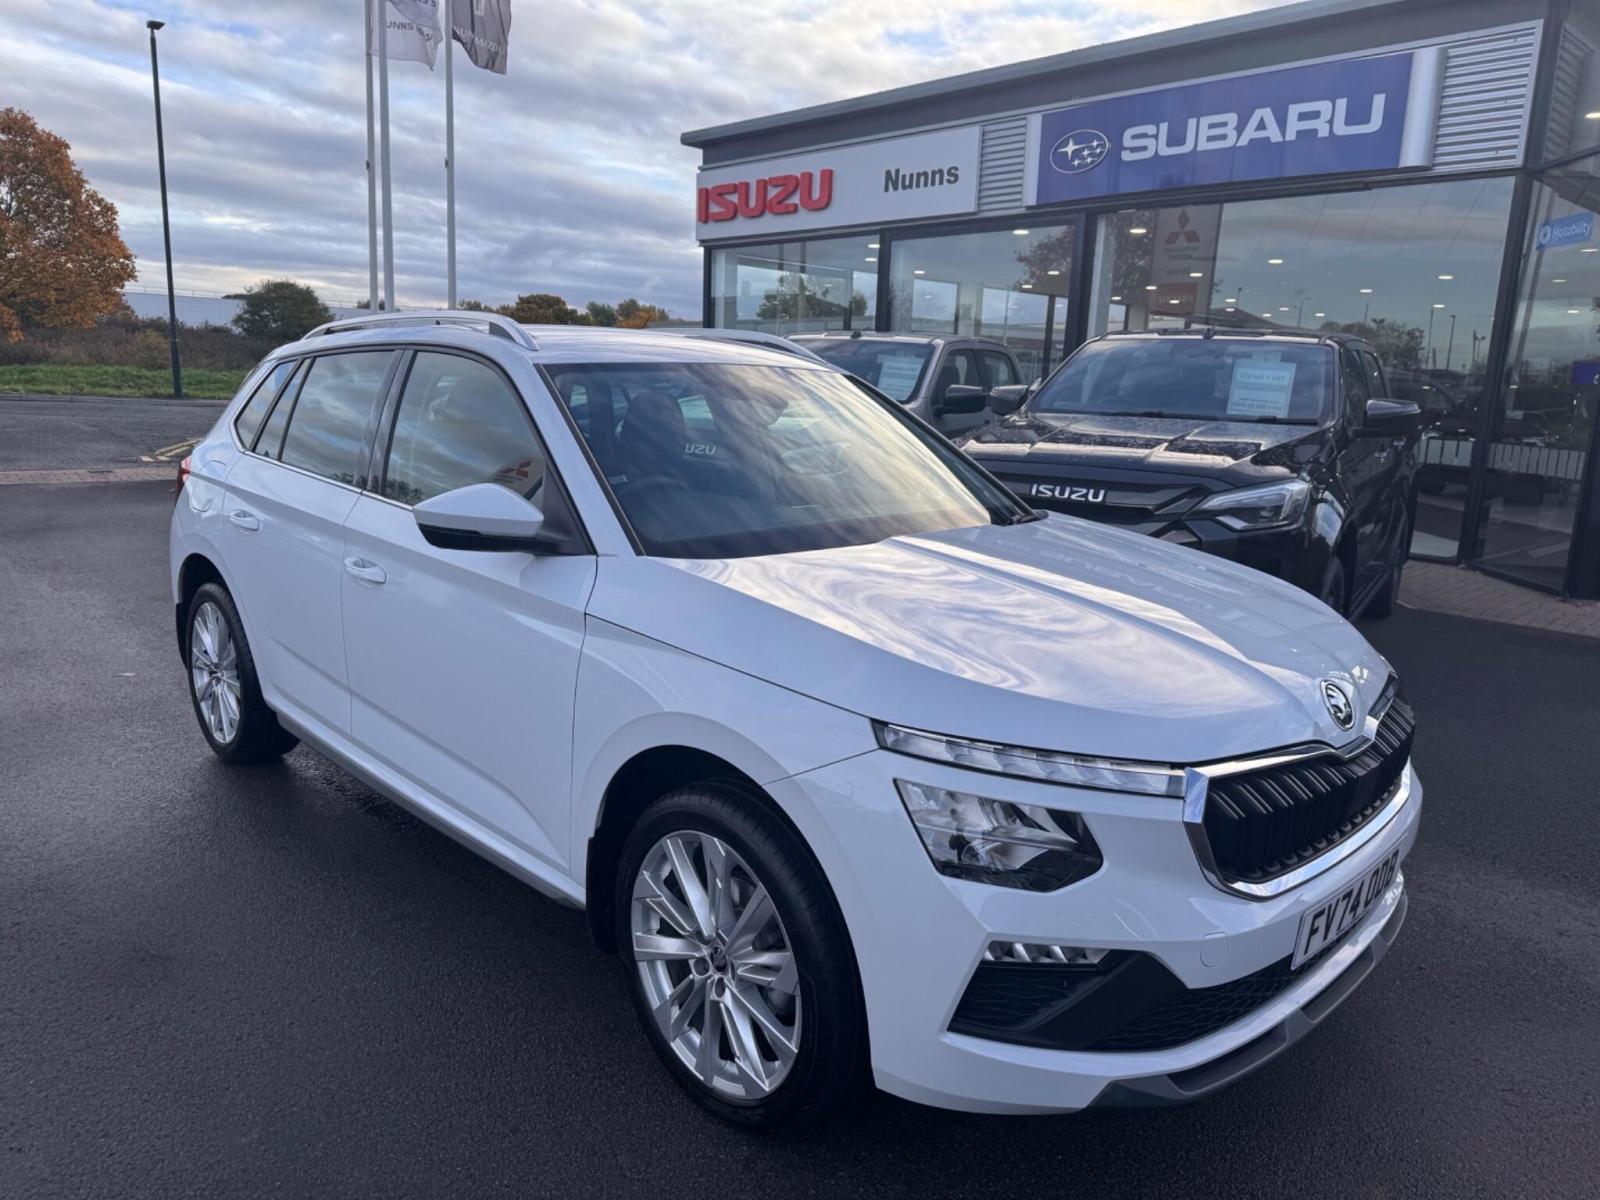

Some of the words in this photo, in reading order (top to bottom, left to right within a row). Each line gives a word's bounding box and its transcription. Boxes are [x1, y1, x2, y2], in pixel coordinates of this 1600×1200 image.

[1120, 93, 1386, 162] SUBARU
[698, 168, 834, 224] ISUZU
[883, 165, 960, 193] Nunns
[1031, 483, 1105, 502] ISUZU
[1303, 879, 1365, 956] FV74
